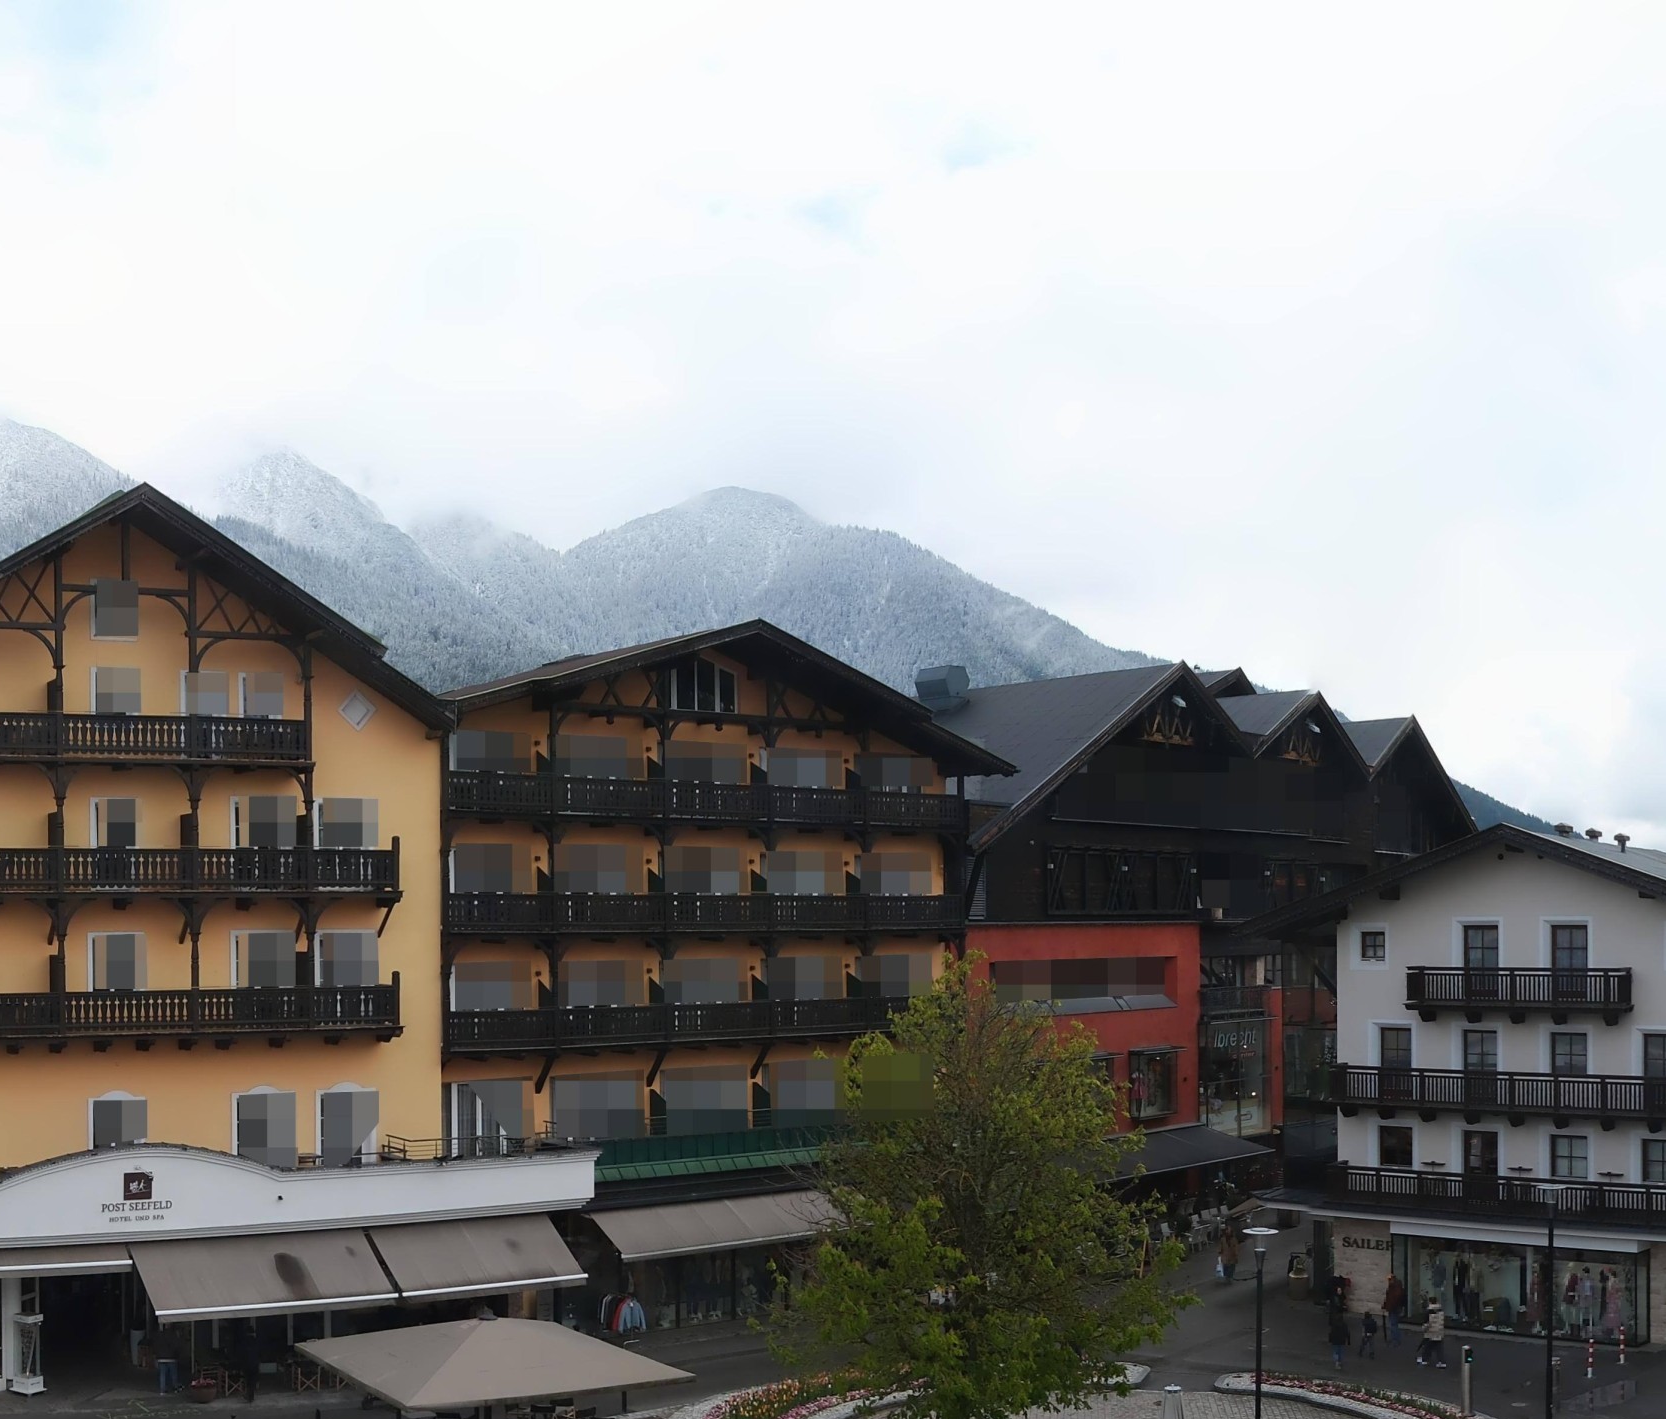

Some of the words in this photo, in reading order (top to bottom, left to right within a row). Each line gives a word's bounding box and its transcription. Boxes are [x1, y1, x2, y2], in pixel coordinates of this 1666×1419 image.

[101, 1202, 127, 1213] POST
[129, 1200, 173, 1211] SEEFELD
[109, 1215, 132, 1223] HOTEL
